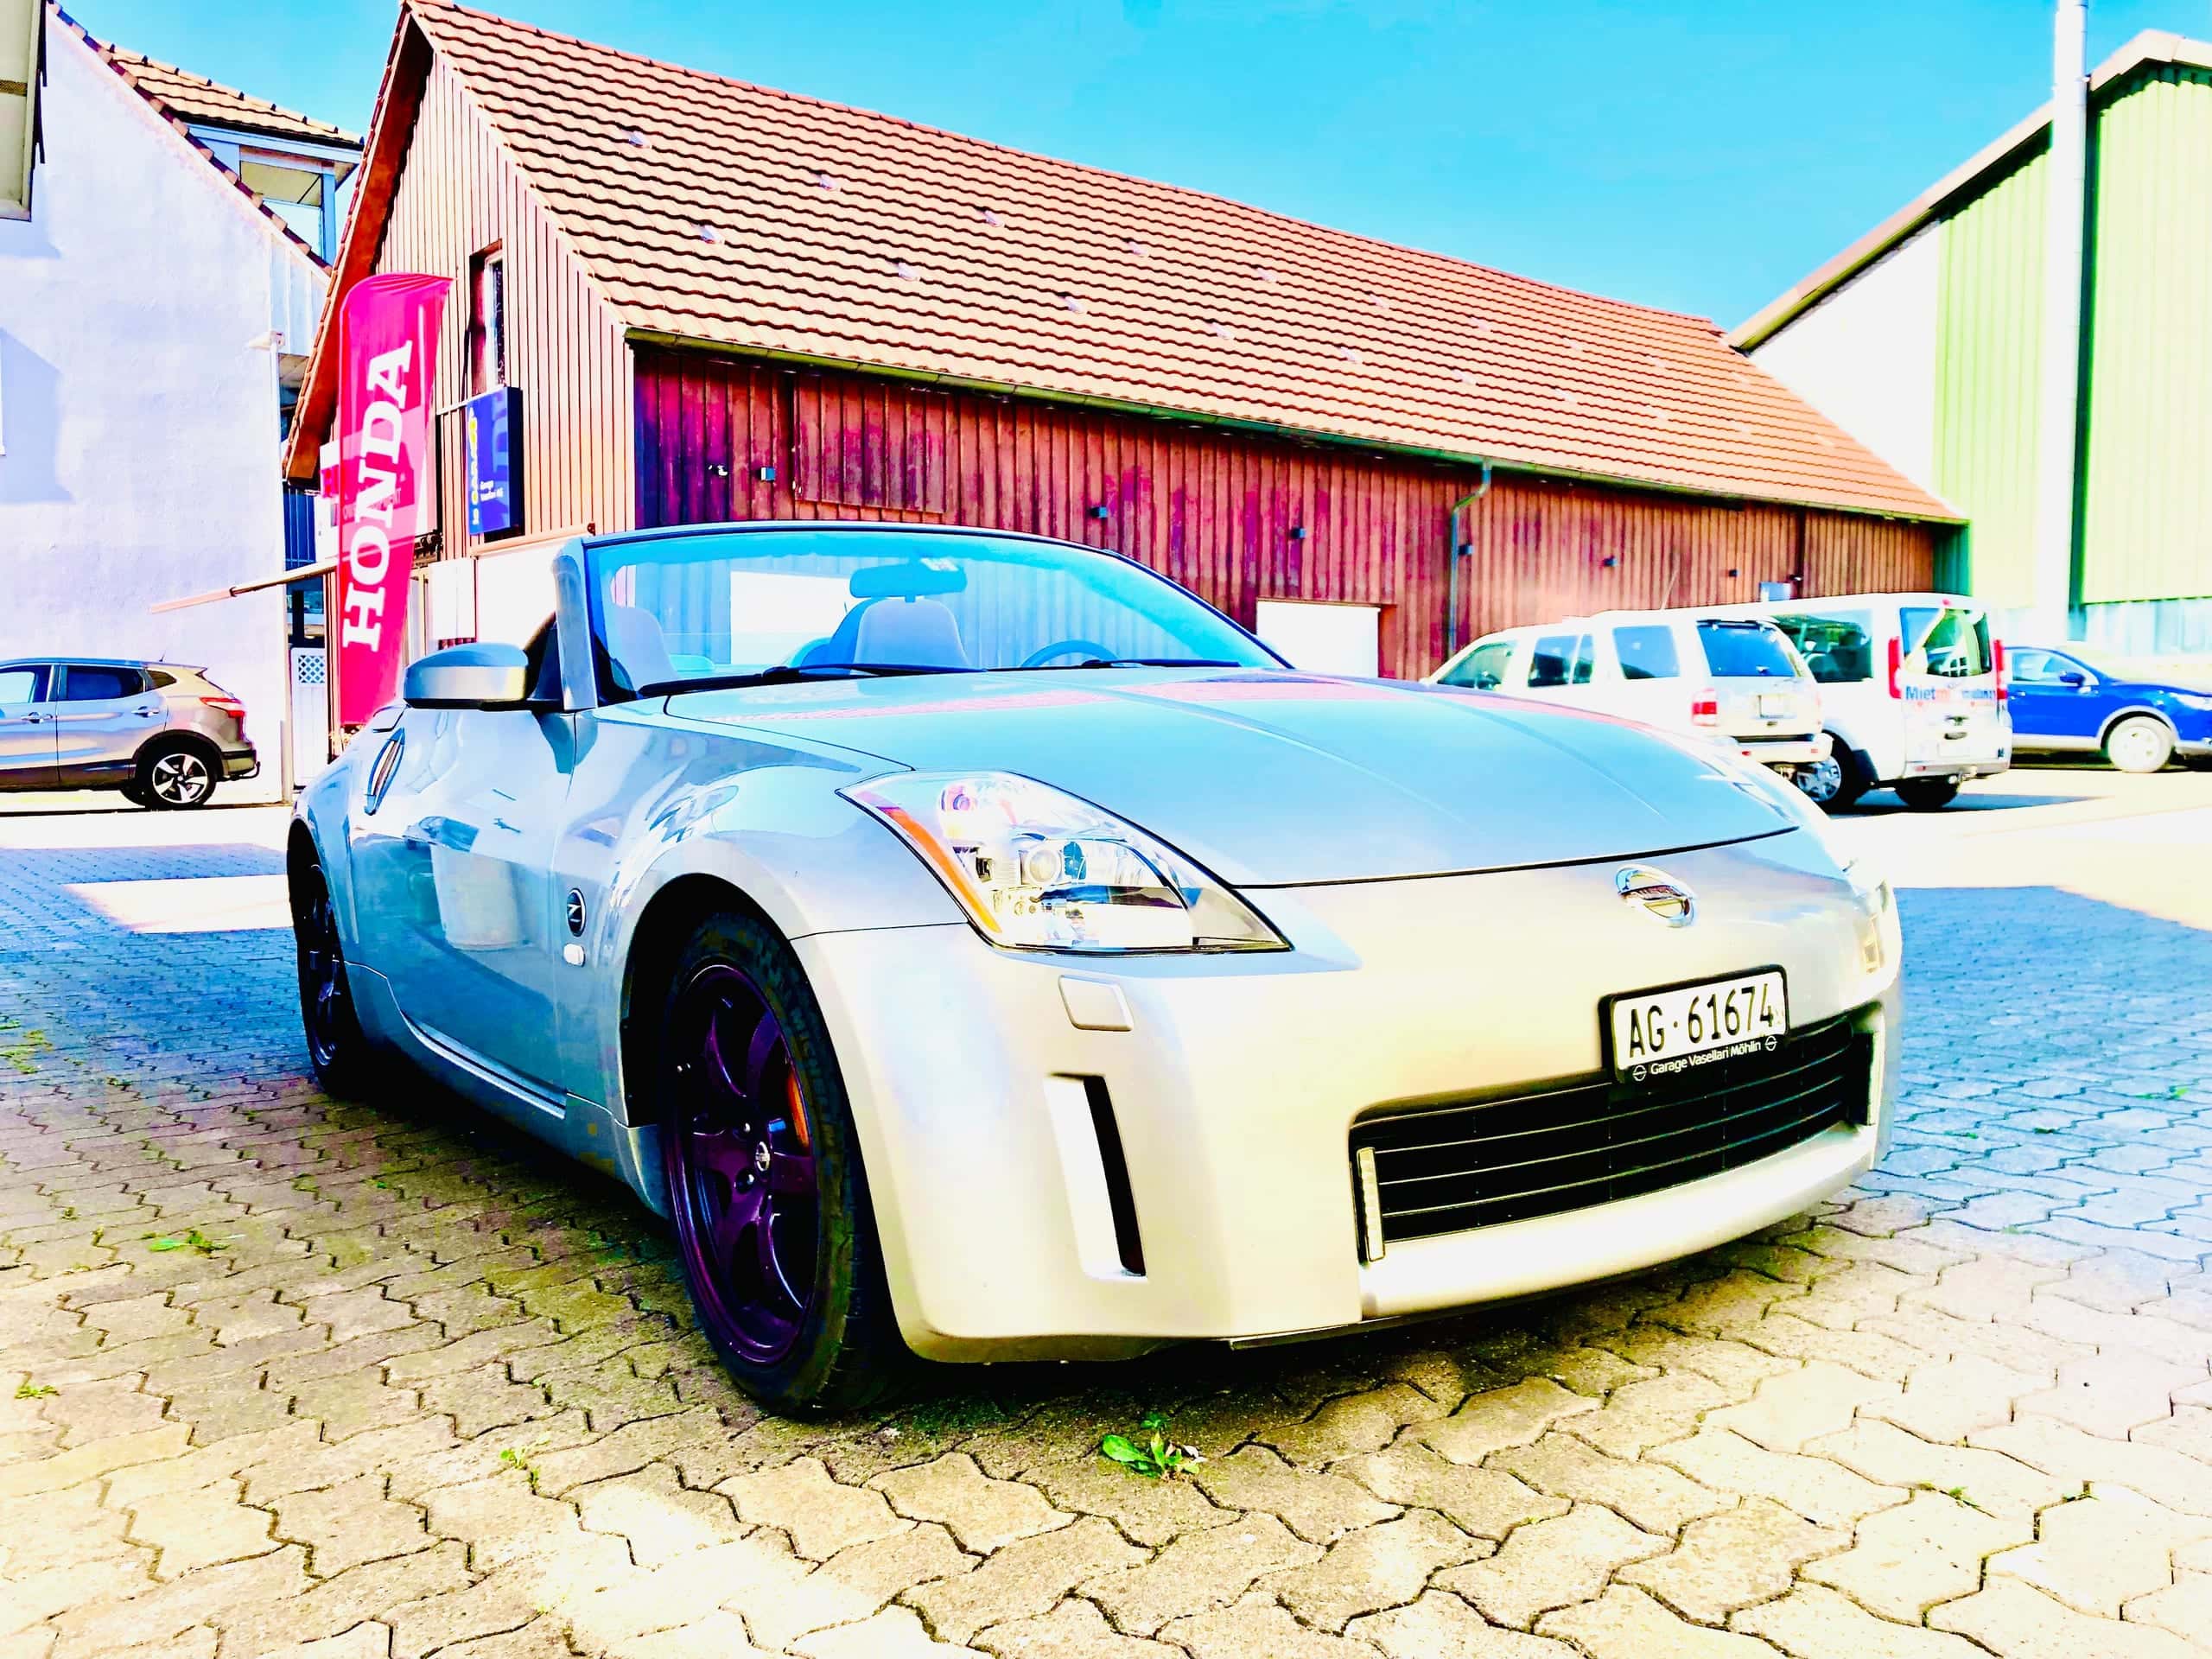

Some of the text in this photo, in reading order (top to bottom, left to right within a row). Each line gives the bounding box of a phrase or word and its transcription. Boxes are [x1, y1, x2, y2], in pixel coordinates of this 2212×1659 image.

[342, 339, 413, 652] HONDA
[1650, 1039, 1762, 1075] Garage Vasellari Möhlin
